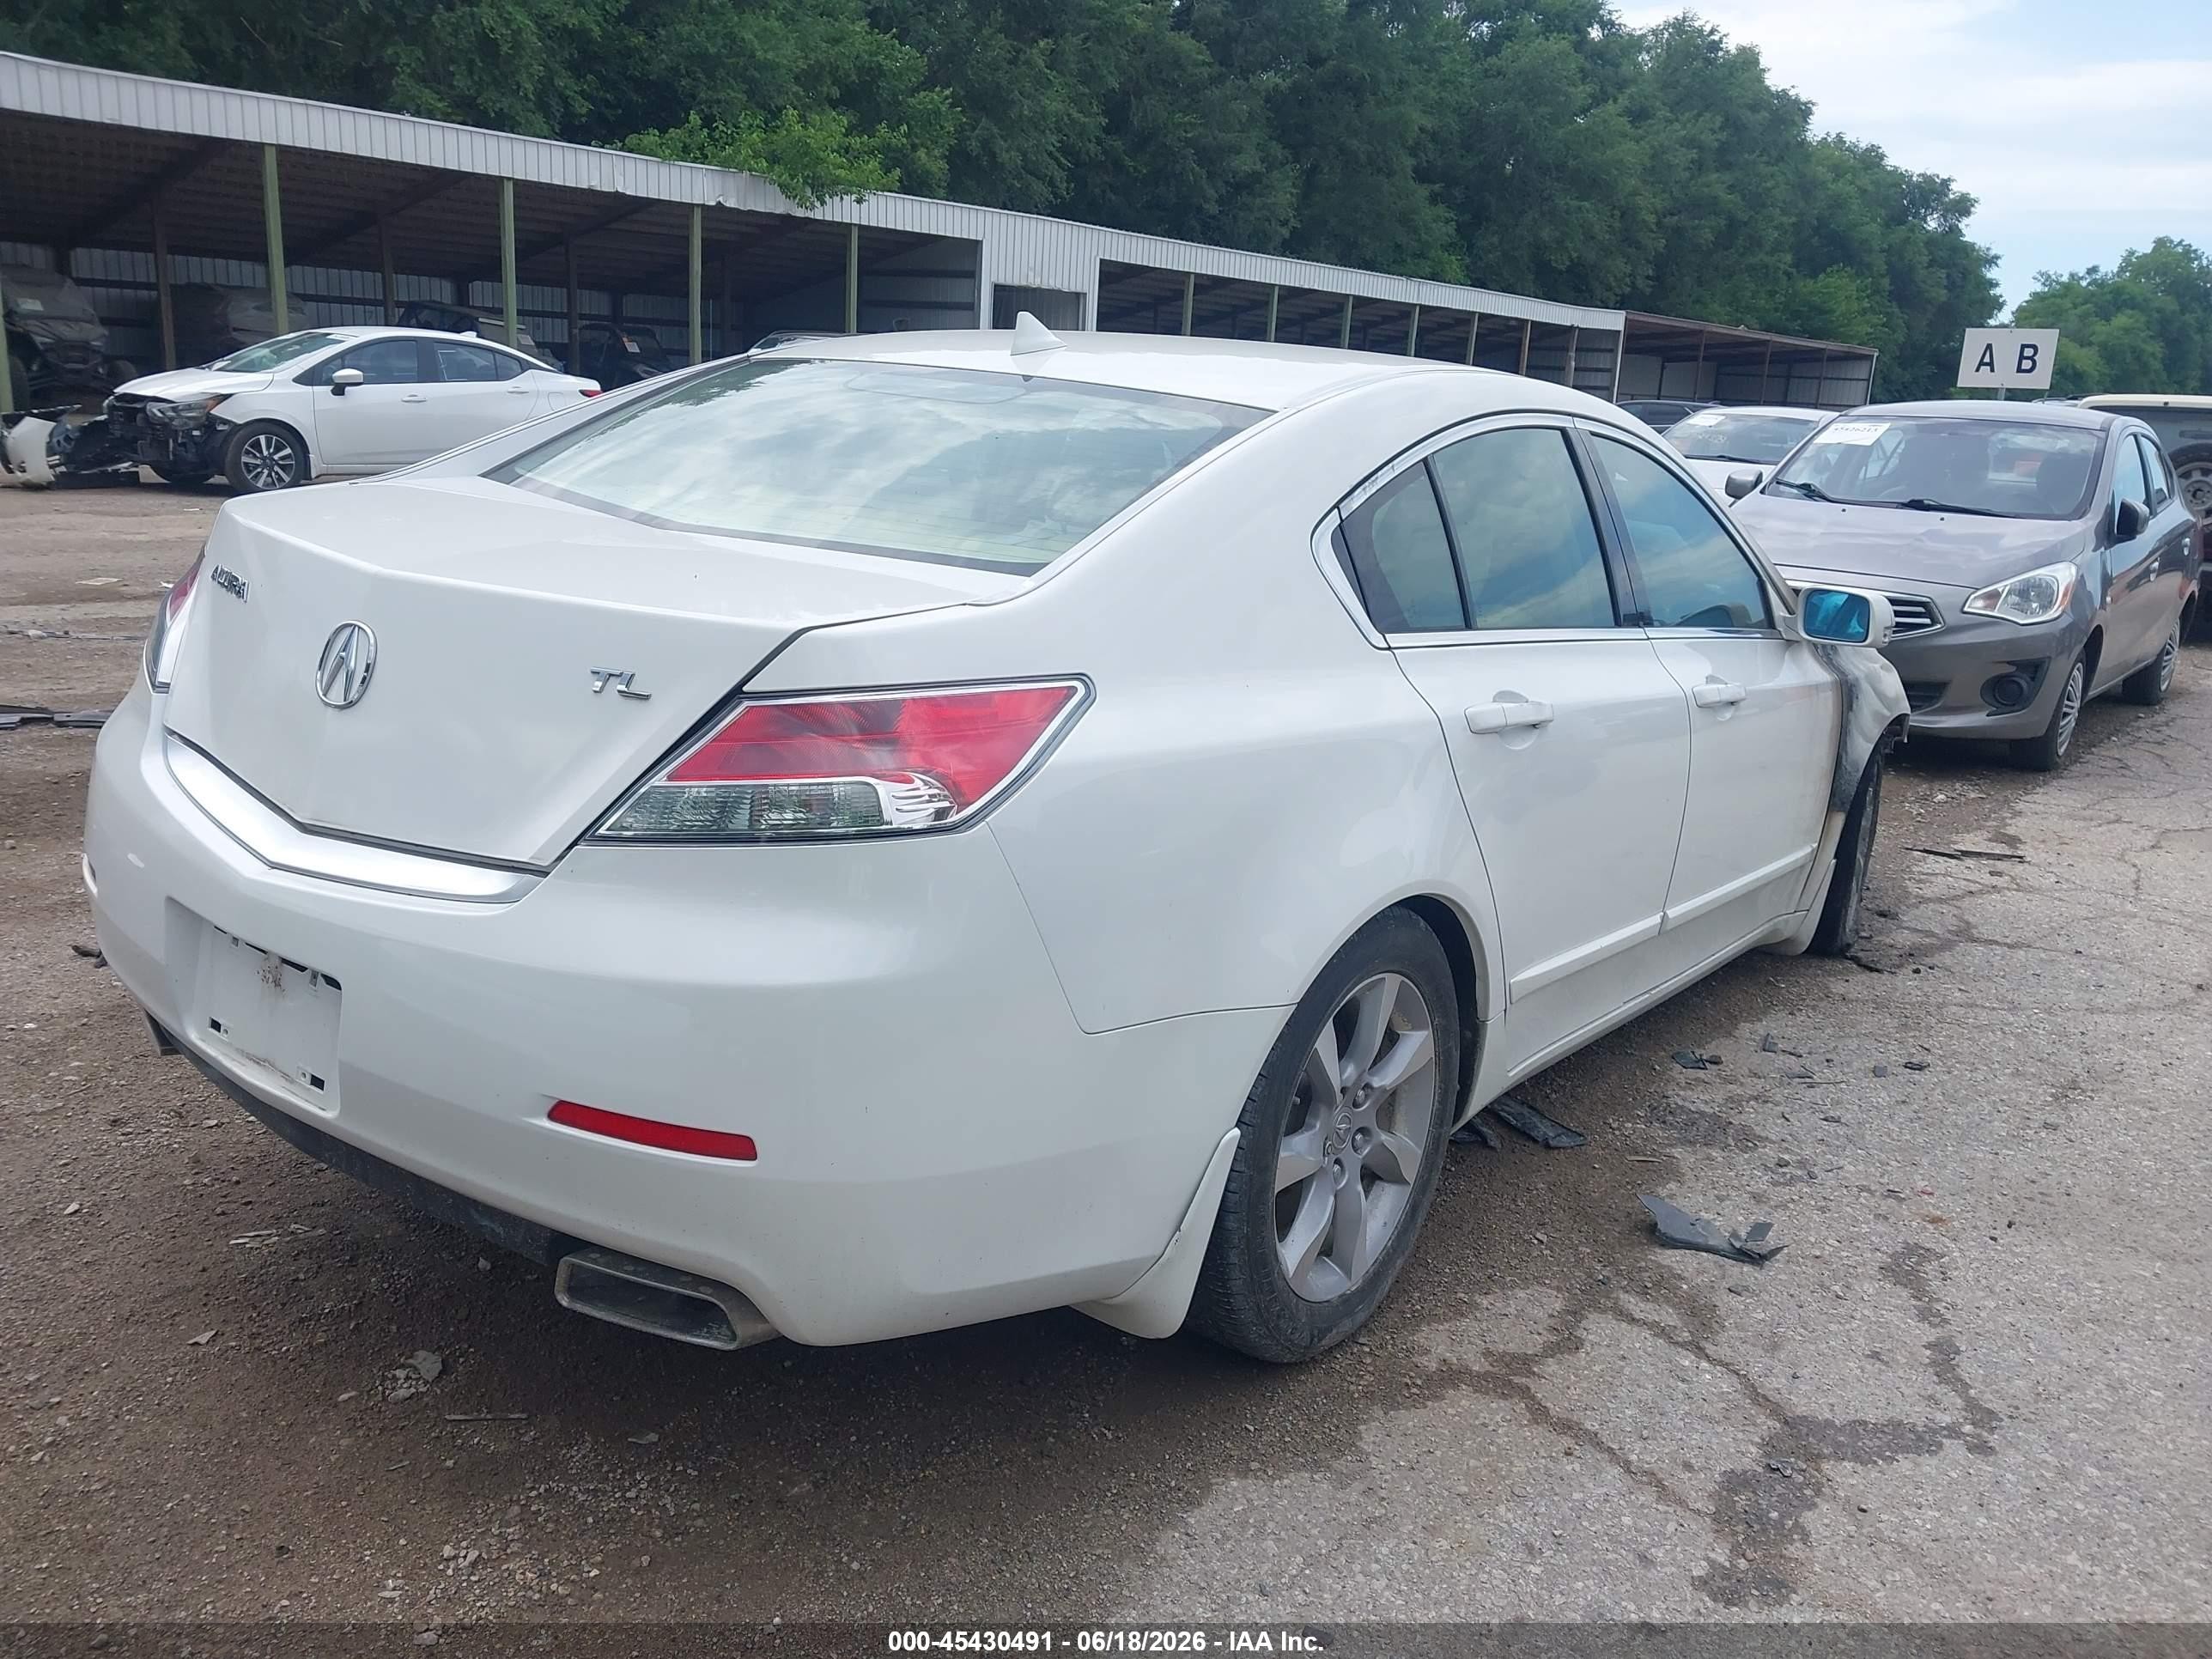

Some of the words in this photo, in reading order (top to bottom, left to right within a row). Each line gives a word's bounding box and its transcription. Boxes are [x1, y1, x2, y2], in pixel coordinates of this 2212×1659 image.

[1974, 343, 1996, 373] A
[2015, 343, 2039, 374] B
[210, 563, 250, 604] ACURA
[590, 665, 653, 701] TL
